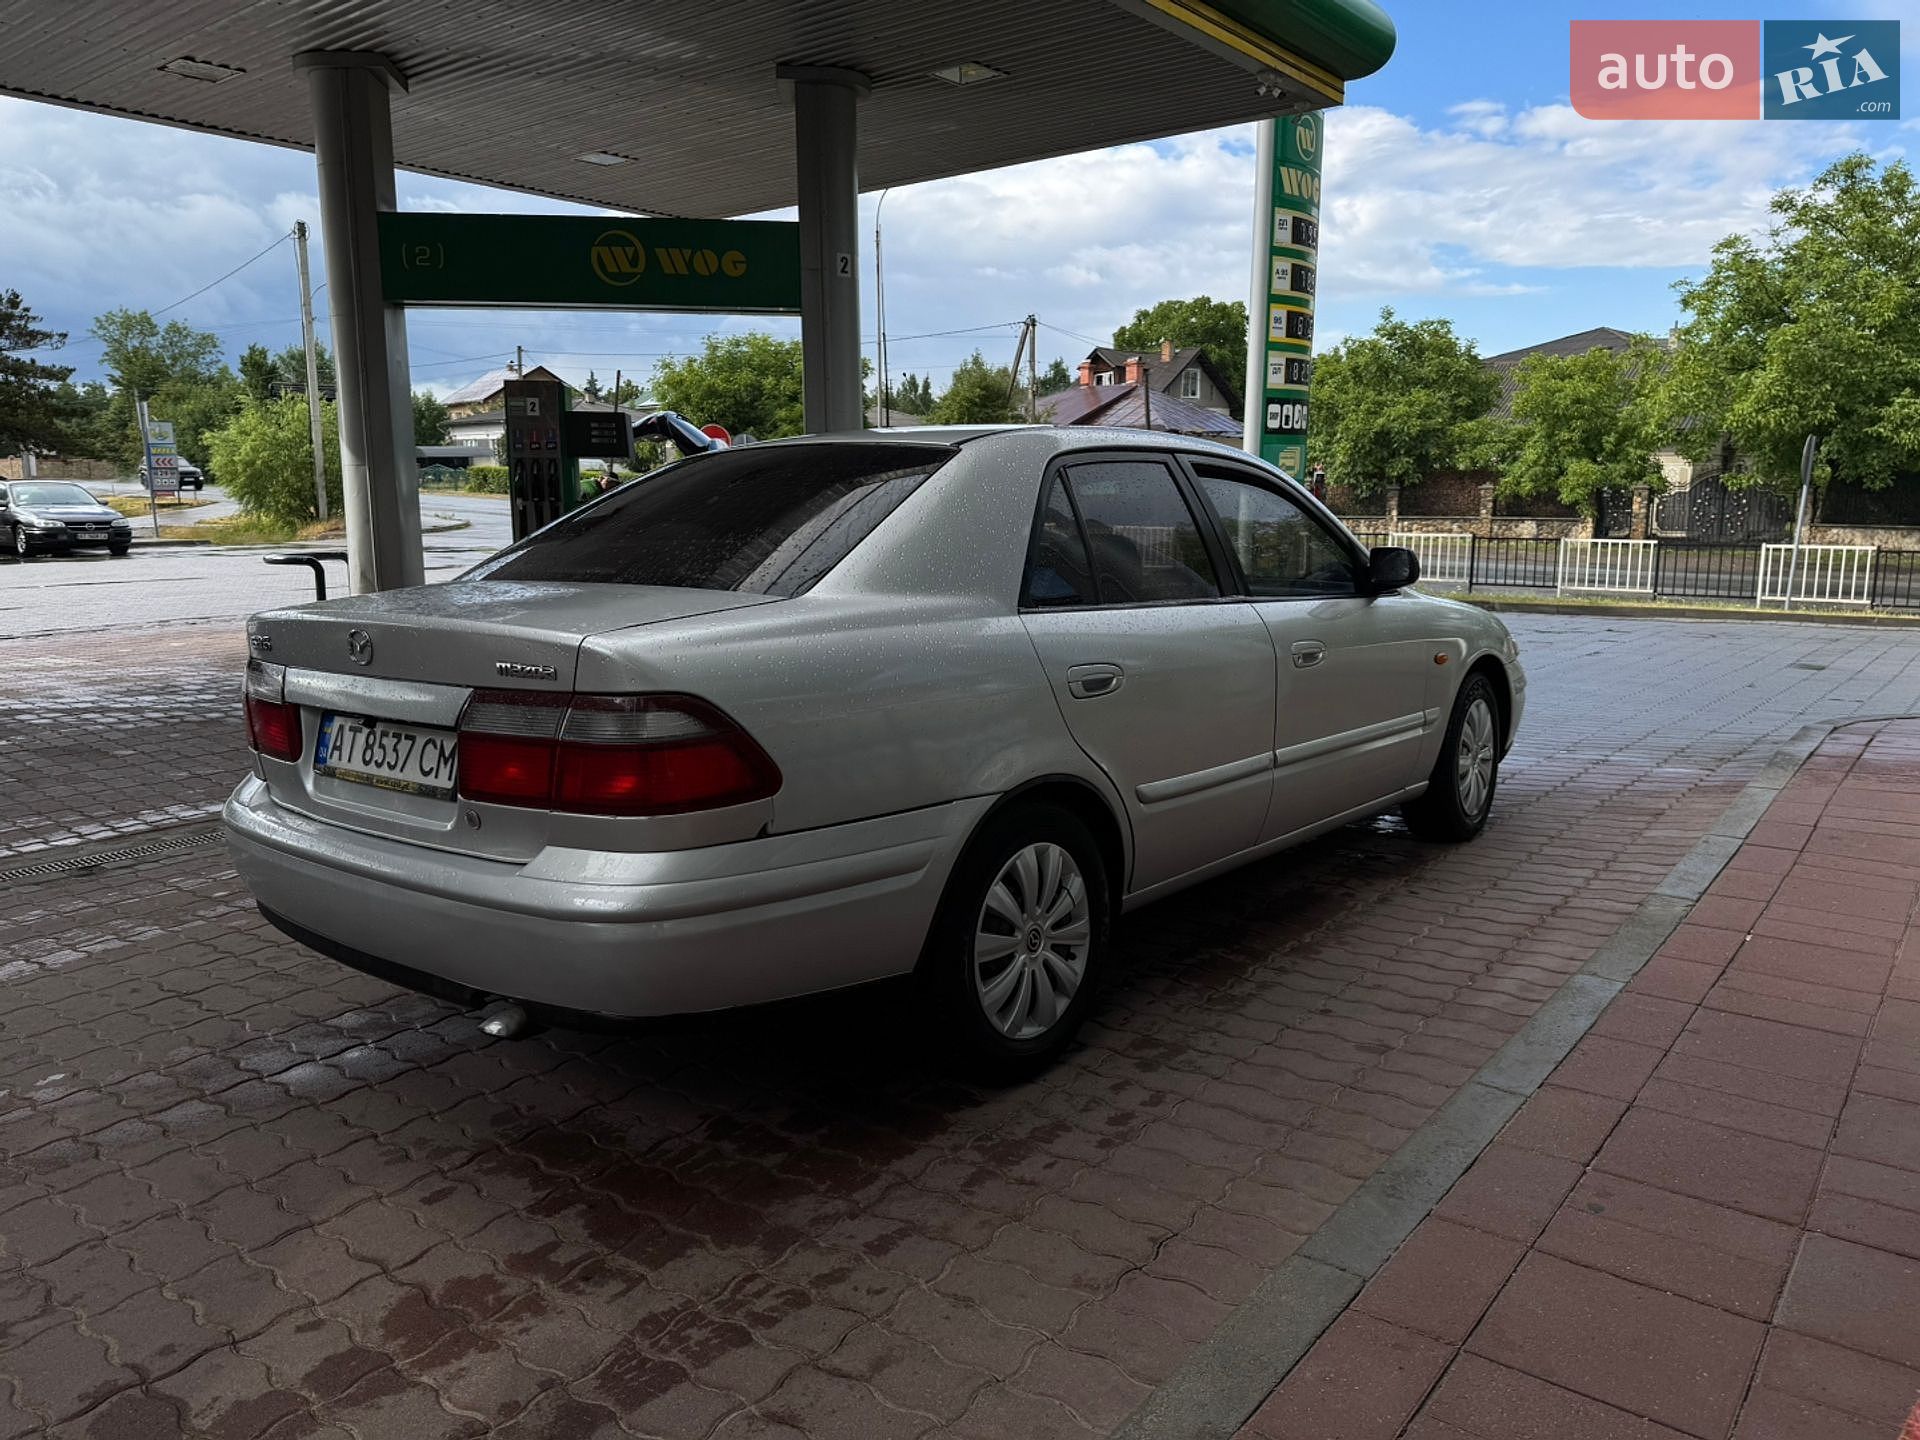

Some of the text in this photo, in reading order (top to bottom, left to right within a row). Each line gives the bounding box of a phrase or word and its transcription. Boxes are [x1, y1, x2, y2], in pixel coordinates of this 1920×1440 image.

[654, 247, 748, 278] WOG
[840, 255, 849, 274] 2
[529, 401, 536, 413] 2
[329, 723, 458, 782] AT 8537 CM
